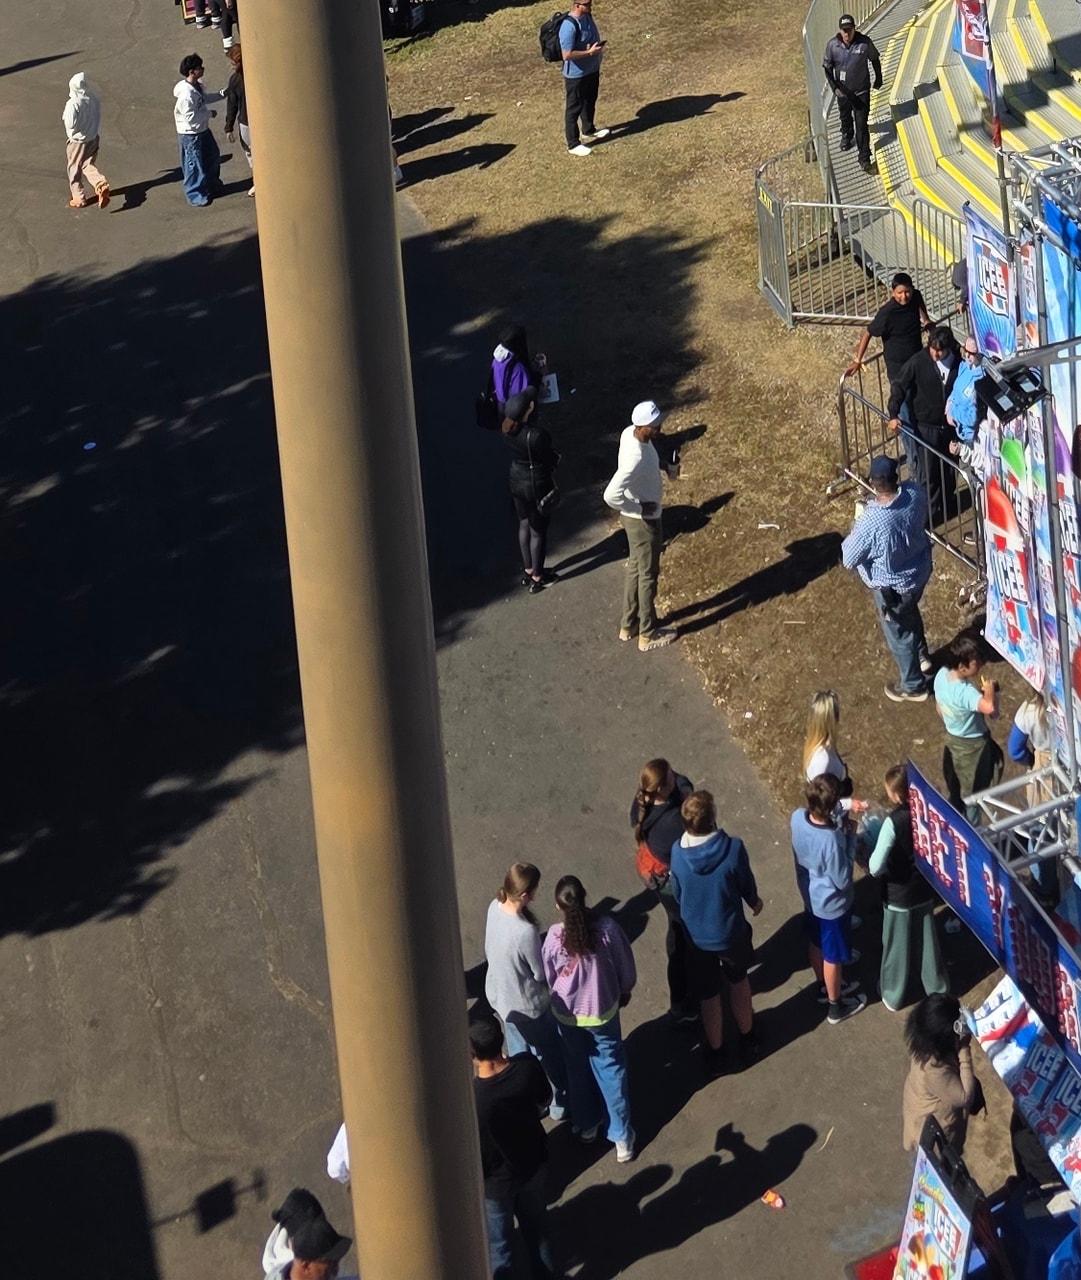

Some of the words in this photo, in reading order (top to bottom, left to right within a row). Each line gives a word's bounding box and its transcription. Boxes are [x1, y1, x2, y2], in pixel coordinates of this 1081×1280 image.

[976, 253, 1008, 300] ICEE
[991, 548, 1030, 607] ICEE
[908, 783, 971, 907] GET
[982, 861, 1081, 1056] YOUR
[1025, 1041, 1066, 1085] ICEE
